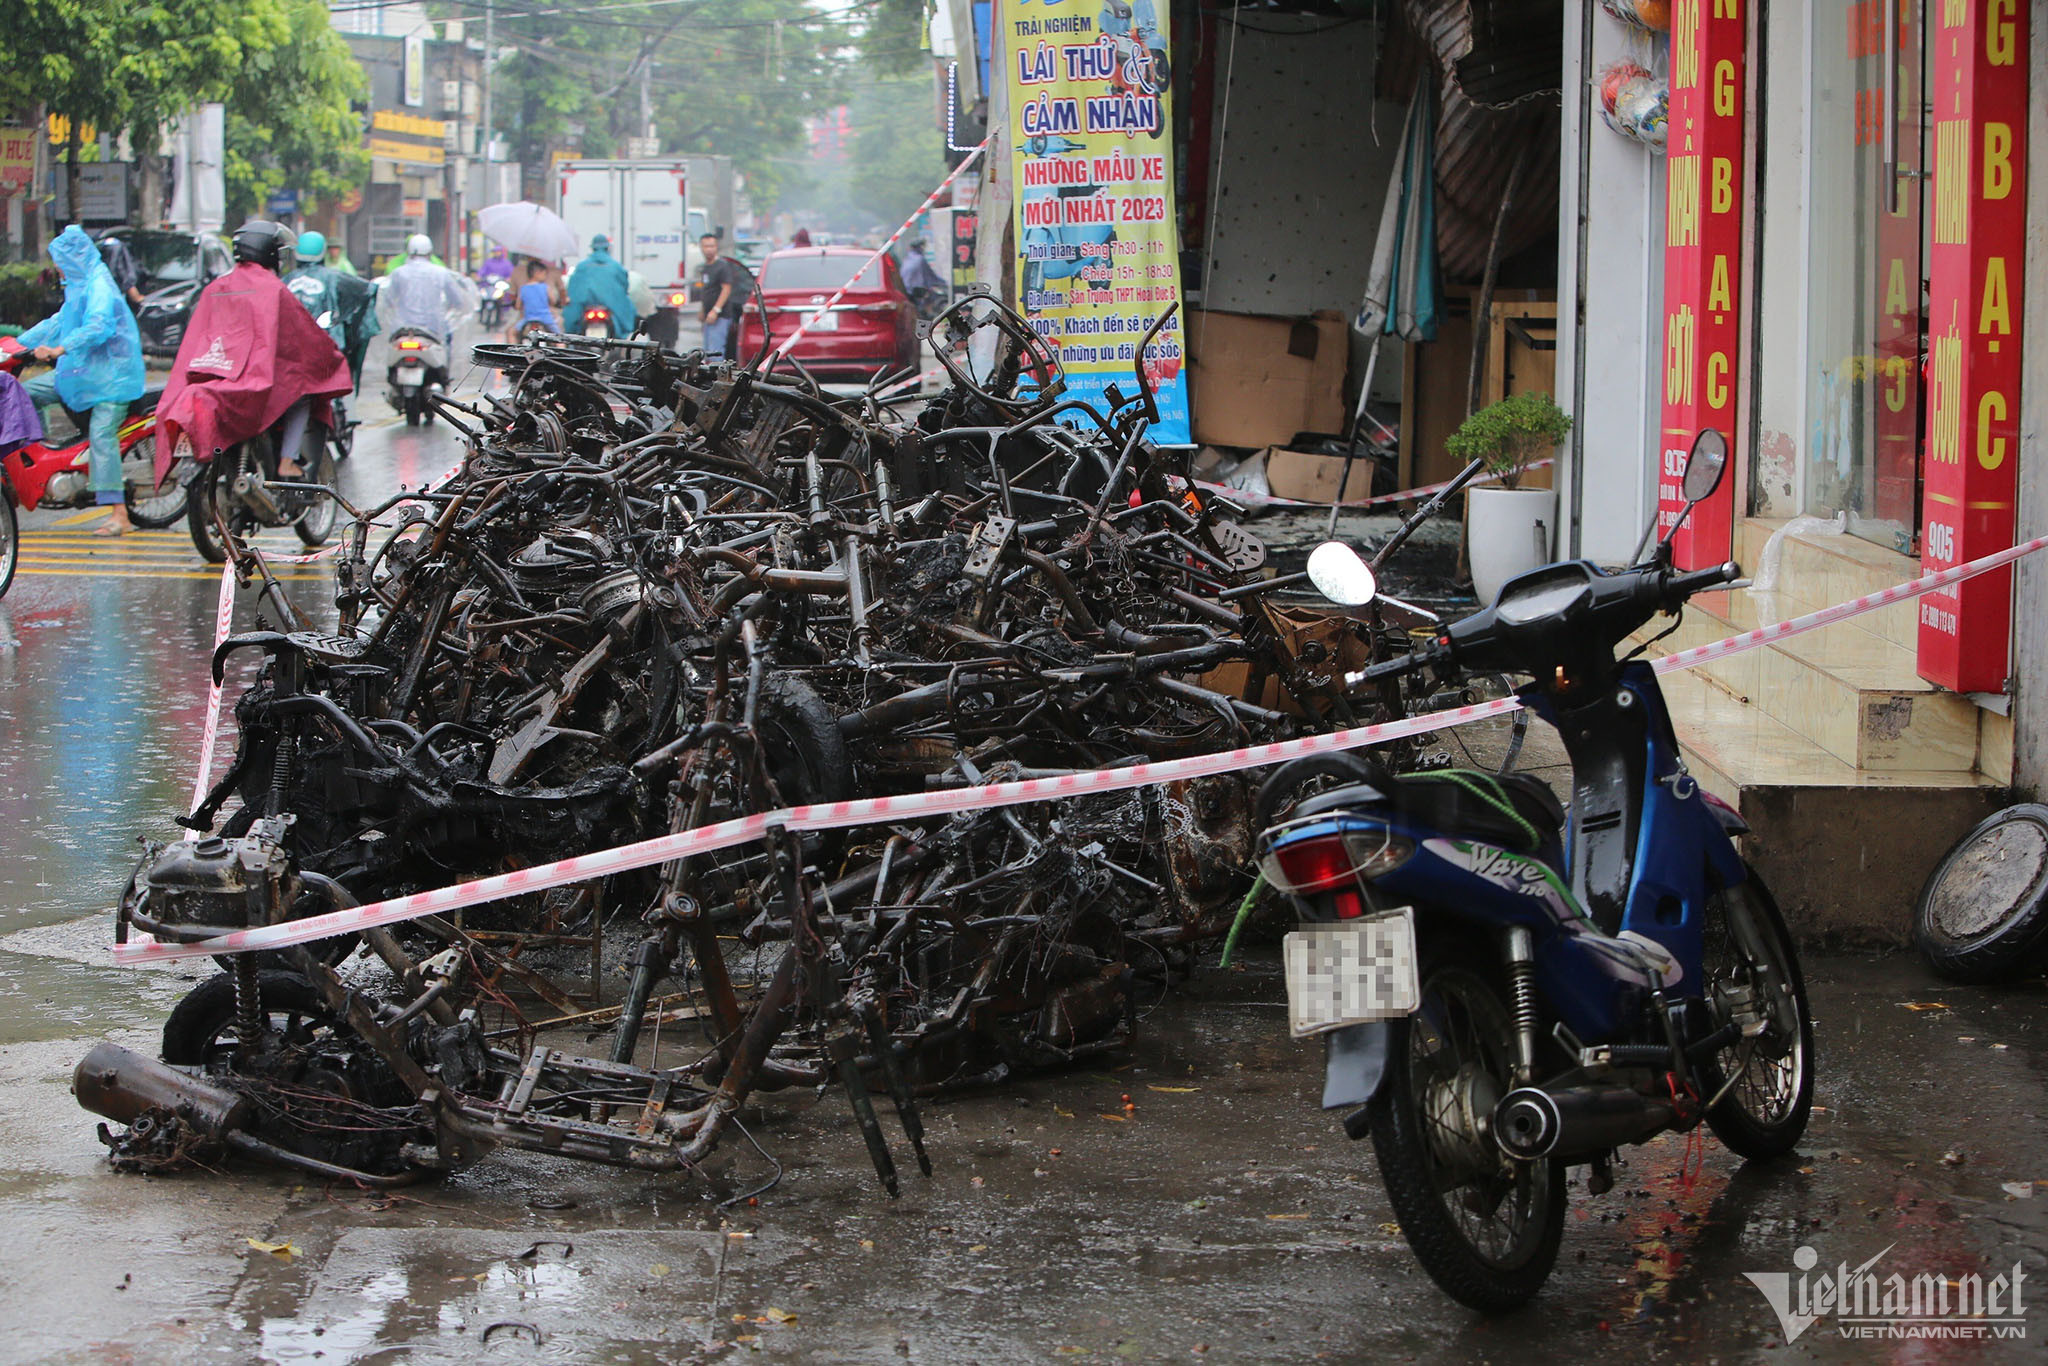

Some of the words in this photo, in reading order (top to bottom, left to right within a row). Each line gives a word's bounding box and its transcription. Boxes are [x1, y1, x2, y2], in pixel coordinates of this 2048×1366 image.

[1015, 16, 1042, 36] TRẢI
[1044, 15, 1091, 36] NGHIỆM
[1018, 41, 1056, 83] LÁI
[1064, 36, 1115, 79] THỬ
[1123, 43, 1155, 93] &
[1023, 94, 1079, 133] CẢM
[1088, 93, 1156, 137] NHẬN
[6, 130, 36, 160] HUẾ
[1025, 156, 1086, 185] NHỮNG
[1094, 149, 1135, 182] MẪU
[1142, 157, 1163, 180] XE
[1026, 196, 1060, 225] MỚI
[1067, 191, 1115, 223] NHẤT
[1123, 198, 1164, 221] 2023
[1028, 243, 1047, 257] Thời
[1051, 243, 1075, 259] gian:
[1081, 242, 1109, 259] Sáng
[1111, 241, 1136, 255] 7h30
[1146, 240, 1164, 254] 11h
[1082, 264, 1113, 280] Chiều
[1117, 265, 1135, 279] 15h
[1145, 264, 1173, 279] 18h30
[1707, 157, 1732, 410] BẠC
[1116, 288, 1134, 302] THPT
[1170, 285, 1176, 300] B
[1977, 122, 2013, 470] BẠC
[1065, 316, 1100, 334] Khách
[1103, 313, 1123, 332] đến
[1127, 316, 1139, 331] sẽ
[1063, 345, 1096, 362] những
[1100, 346, 1114, 360] ưu
[1118, 344, 1134, 359] đãi
[1144, 344, 1157, 362] ực
[1160, 339, 1179, 358] sốc
[1928, 521, 1954, 562] 905
[1470, 842, 1546, 883] Wave
[1518, 883, 1546, 897] 110
